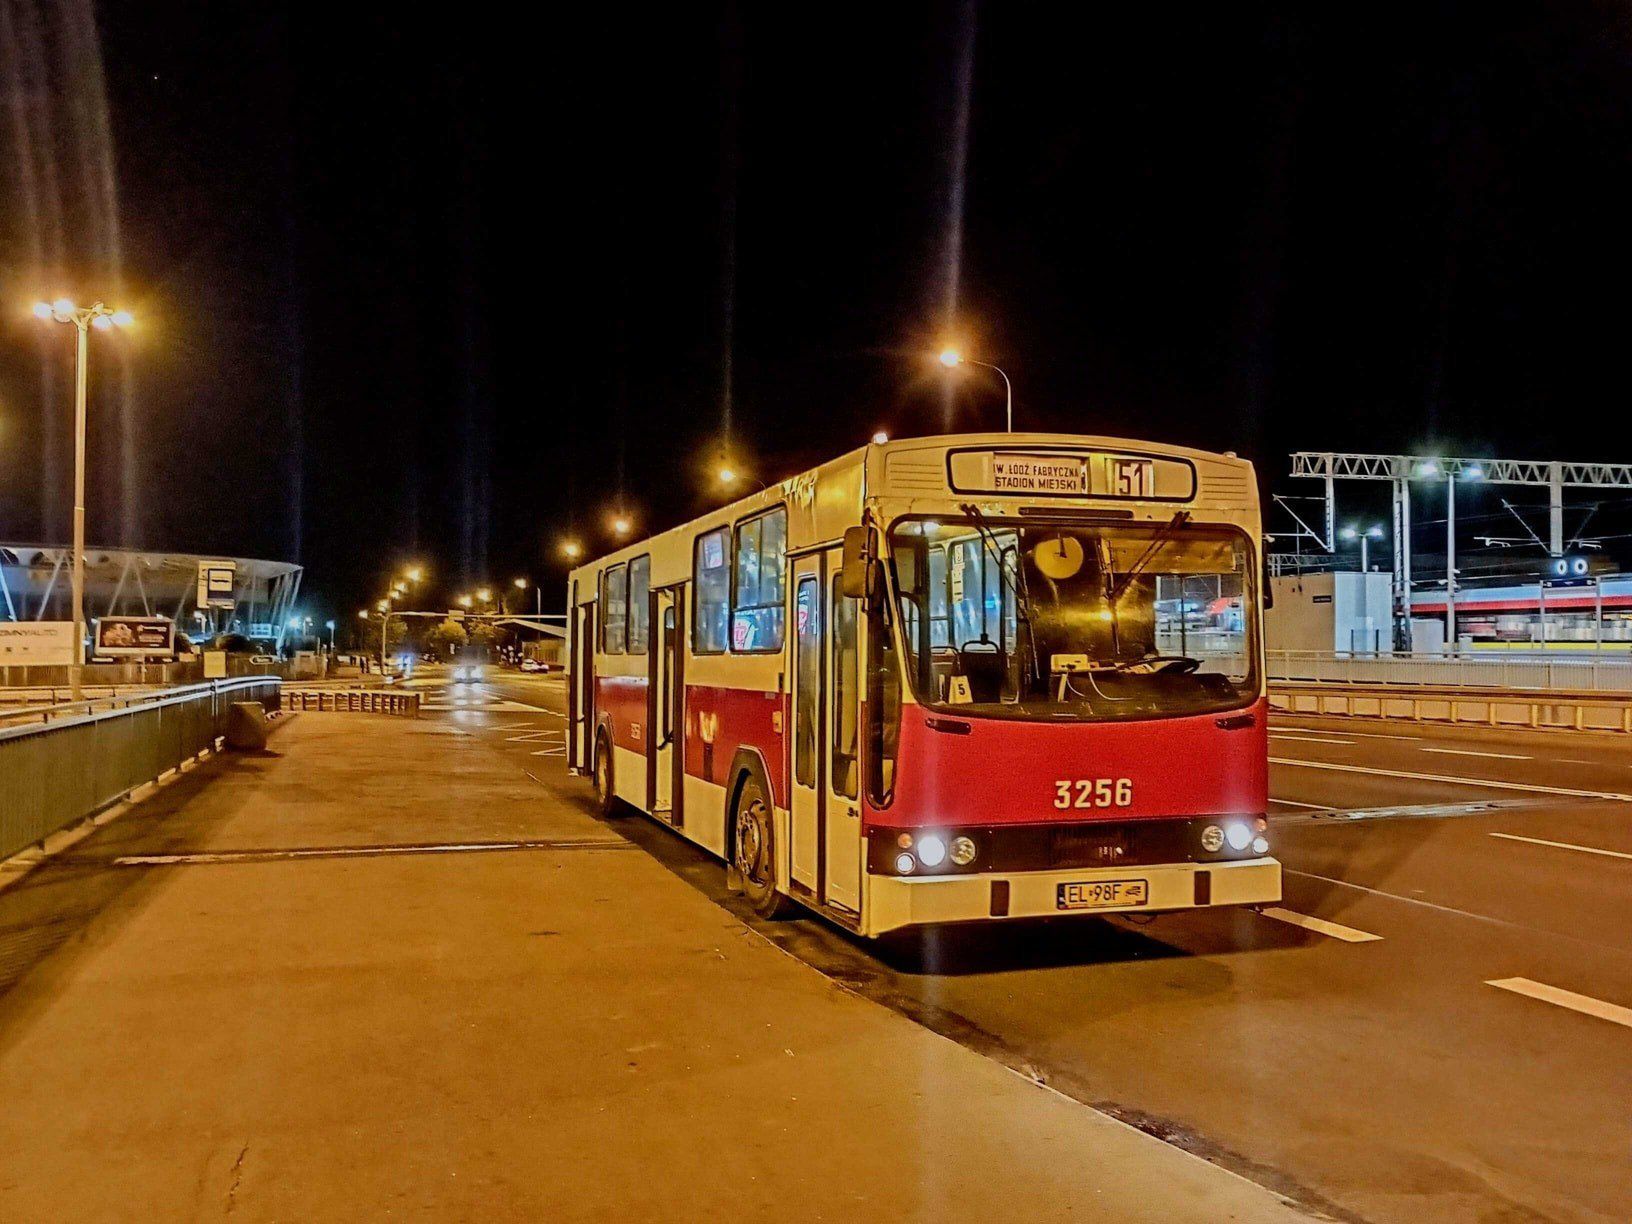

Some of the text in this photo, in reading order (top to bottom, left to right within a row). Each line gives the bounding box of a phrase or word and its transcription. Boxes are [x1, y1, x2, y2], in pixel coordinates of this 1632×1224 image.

[1033, 465, 1079, 478] FABRYCZNA
[1119, 462, 1143, 496] 51
[995, 476, 1076, 490] STADION MIEJSKI
[957, 683, 965, 695] 5
[1053, 778, 1133, 809] 3256
[1069, 884, 1122, 903] EL 98F
